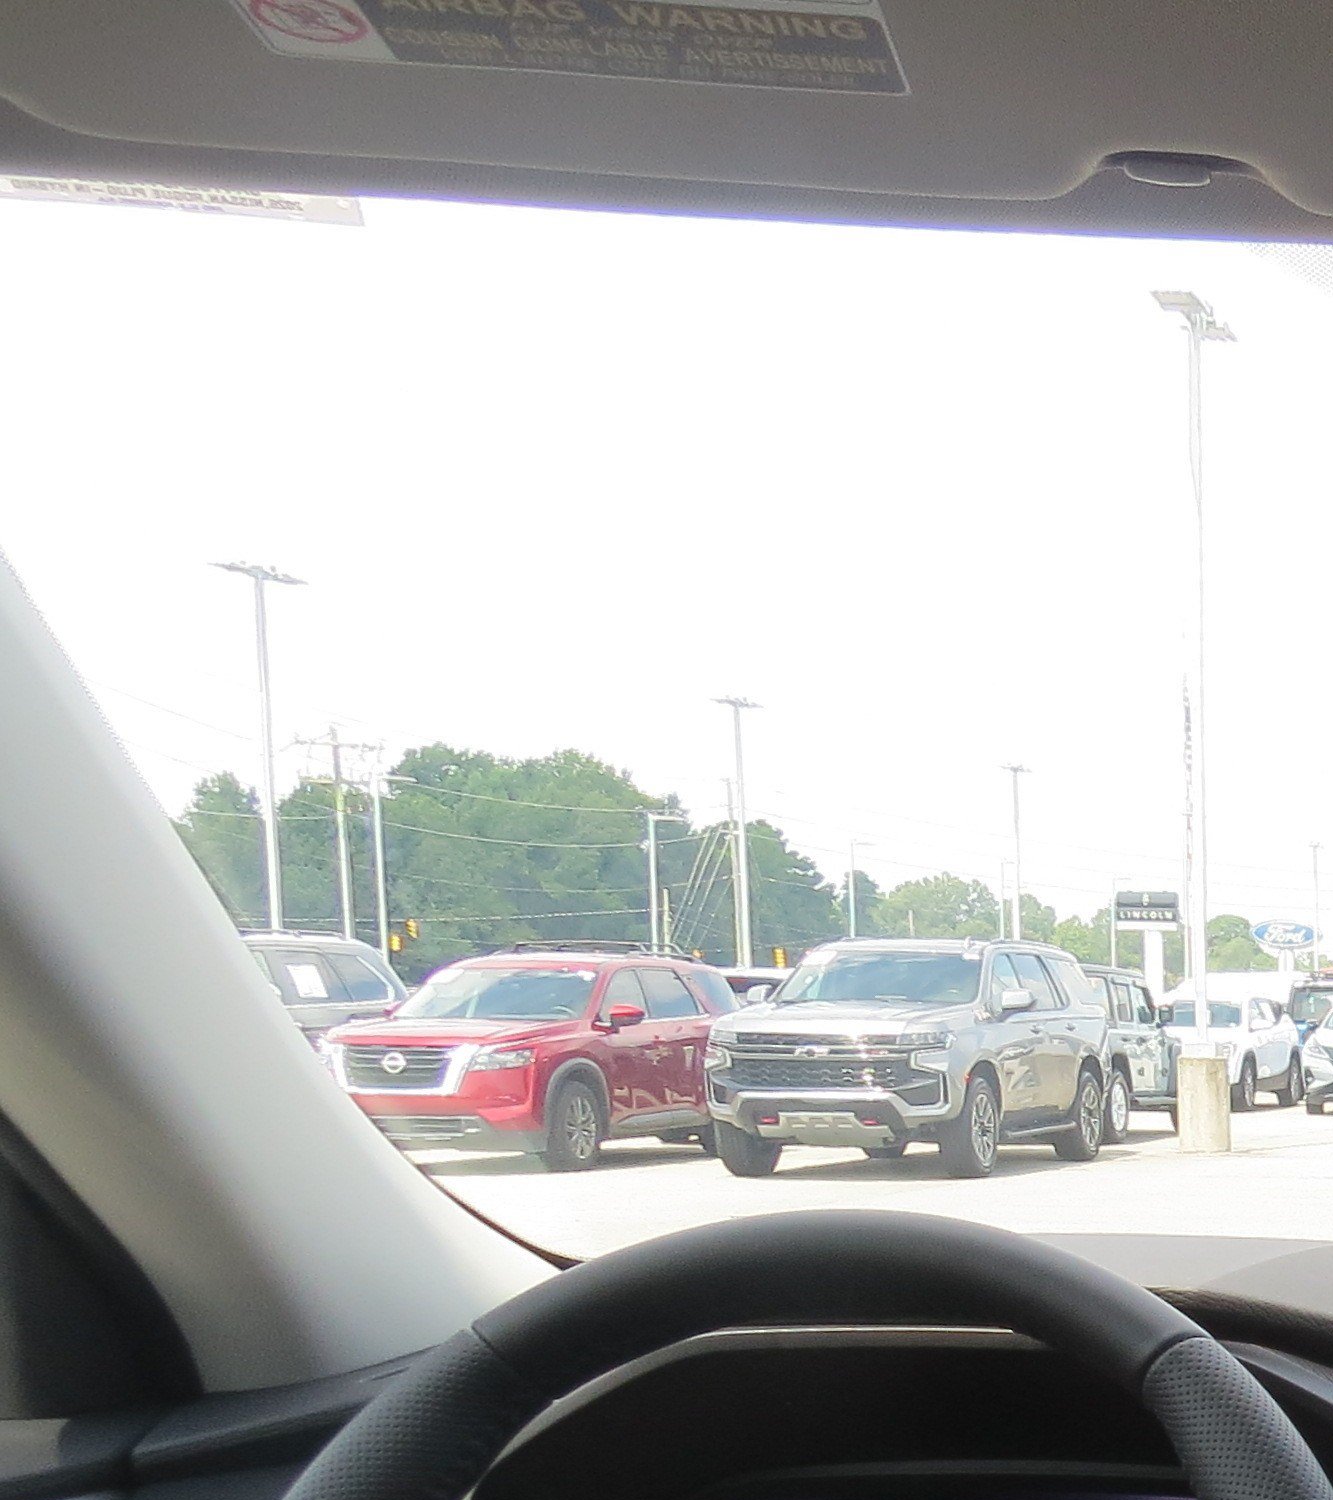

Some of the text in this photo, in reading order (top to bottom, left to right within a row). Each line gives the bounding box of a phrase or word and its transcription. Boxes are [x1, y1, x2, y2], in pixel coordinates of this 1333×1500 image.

[610, 2, 868, 40] WARNING
[682, 48, 888, 75] AVERTISSEMENT
[1119, 910, 1174, 920] LINCOLN
[1264, 922, 1307, 945] Ford
